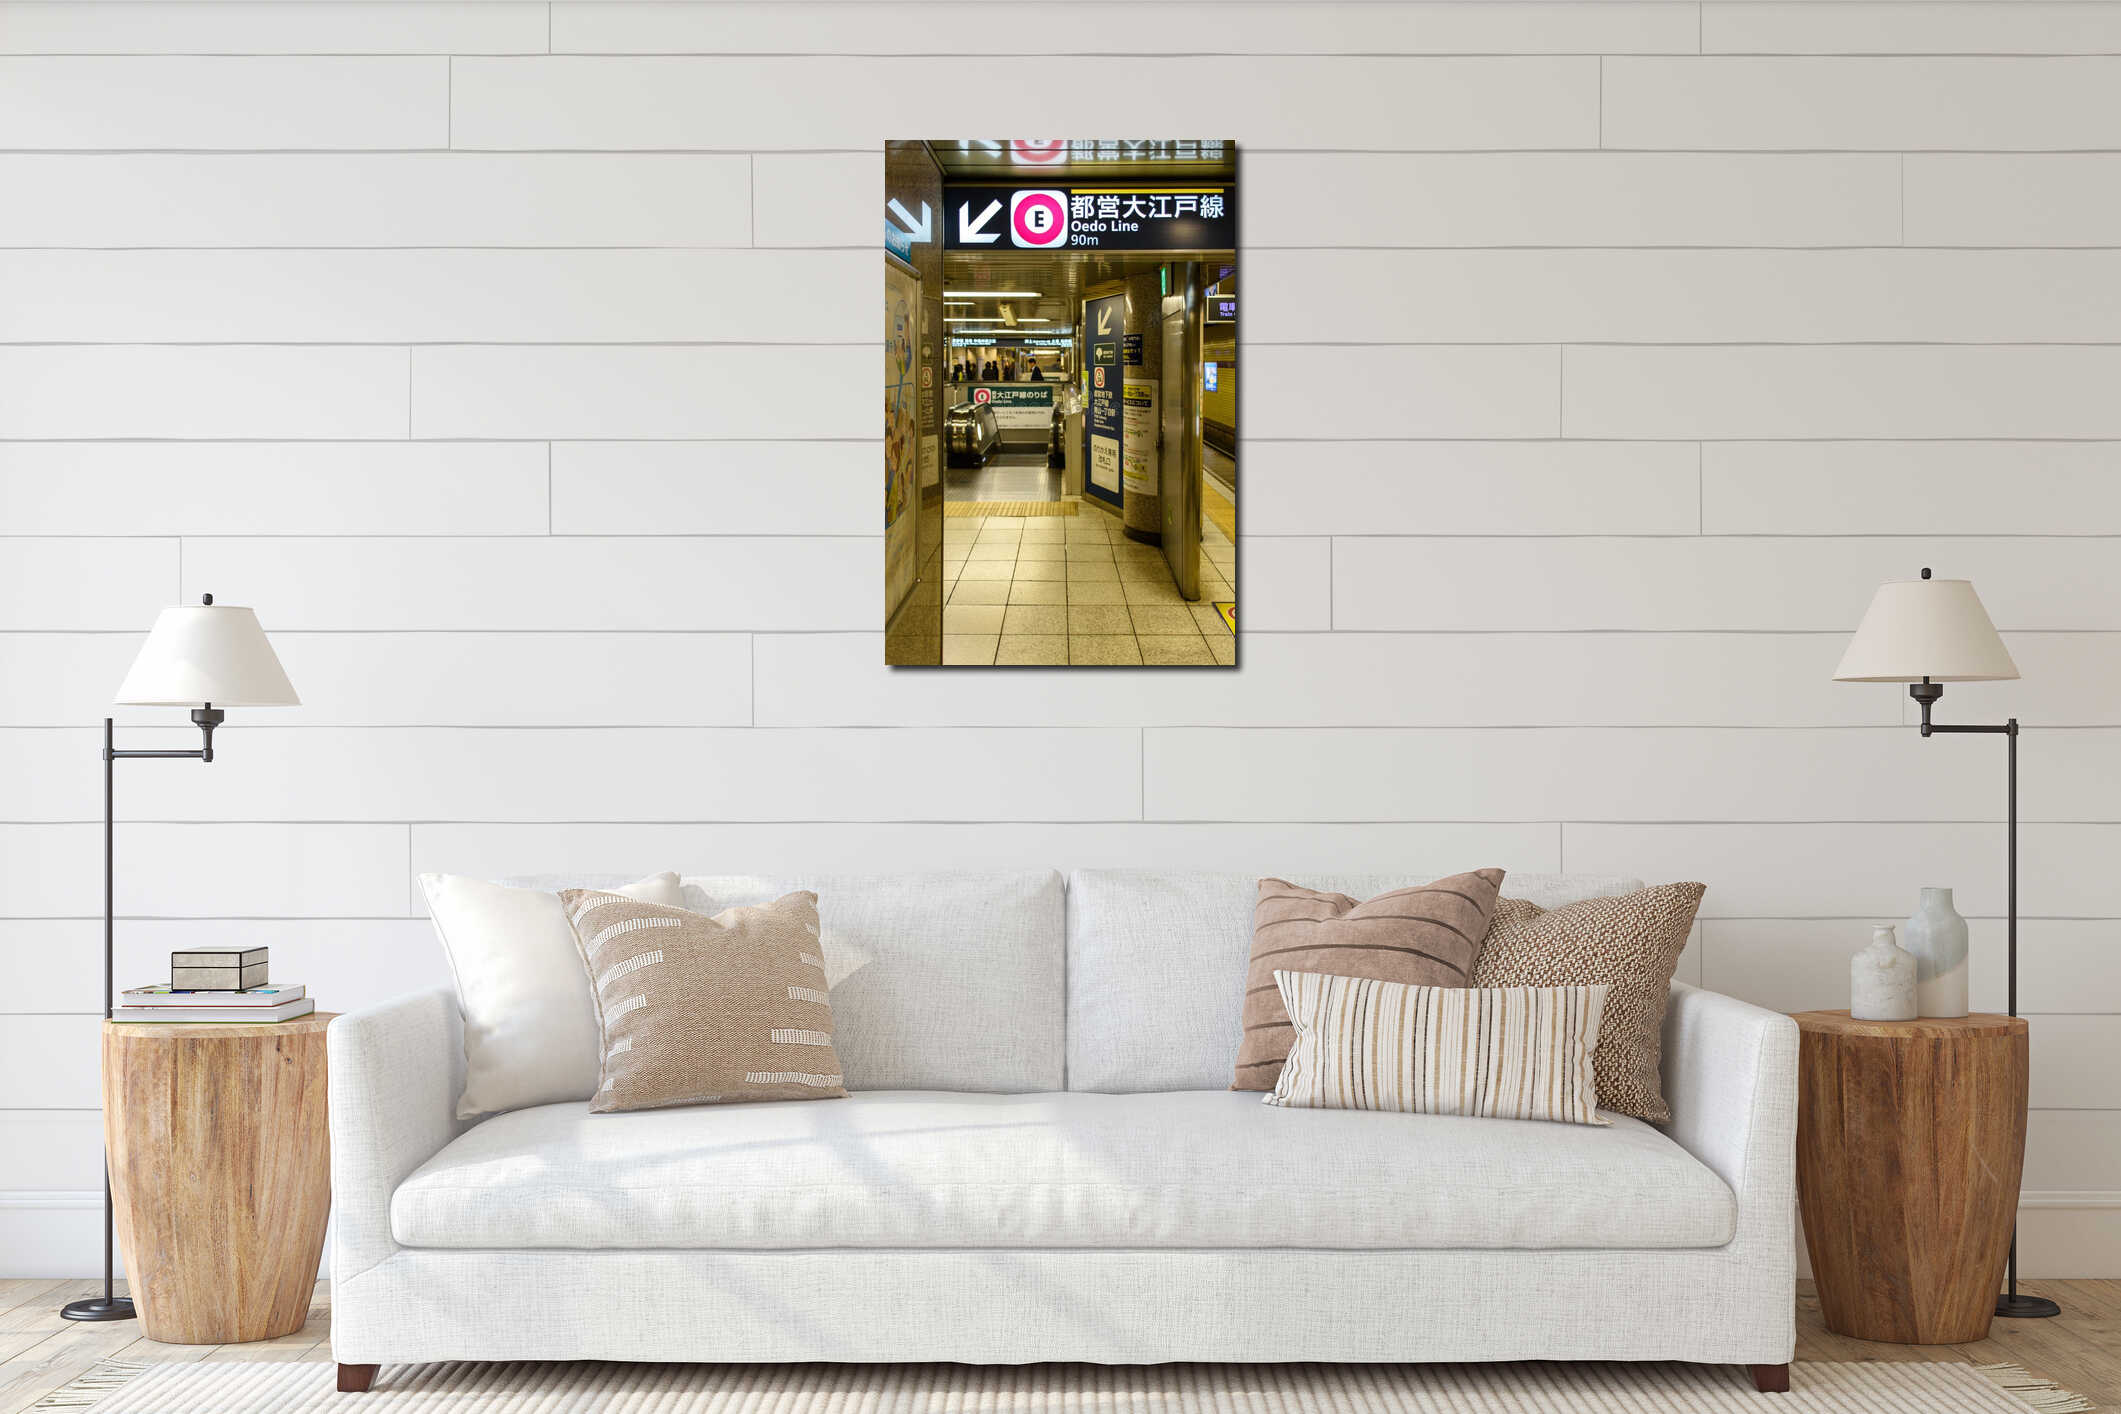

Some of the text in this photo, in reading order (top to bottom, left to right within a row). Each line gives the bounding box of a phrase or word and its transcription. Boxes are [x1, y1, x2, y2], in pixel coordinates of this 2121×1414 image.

[1071, 195, 1224, 219] 都営大江戸線
[1034, 211, 1045, 227] E
[1071, 220, 1139, 232] Oedo Line
[1071, 234, 1099, 246] 90m
